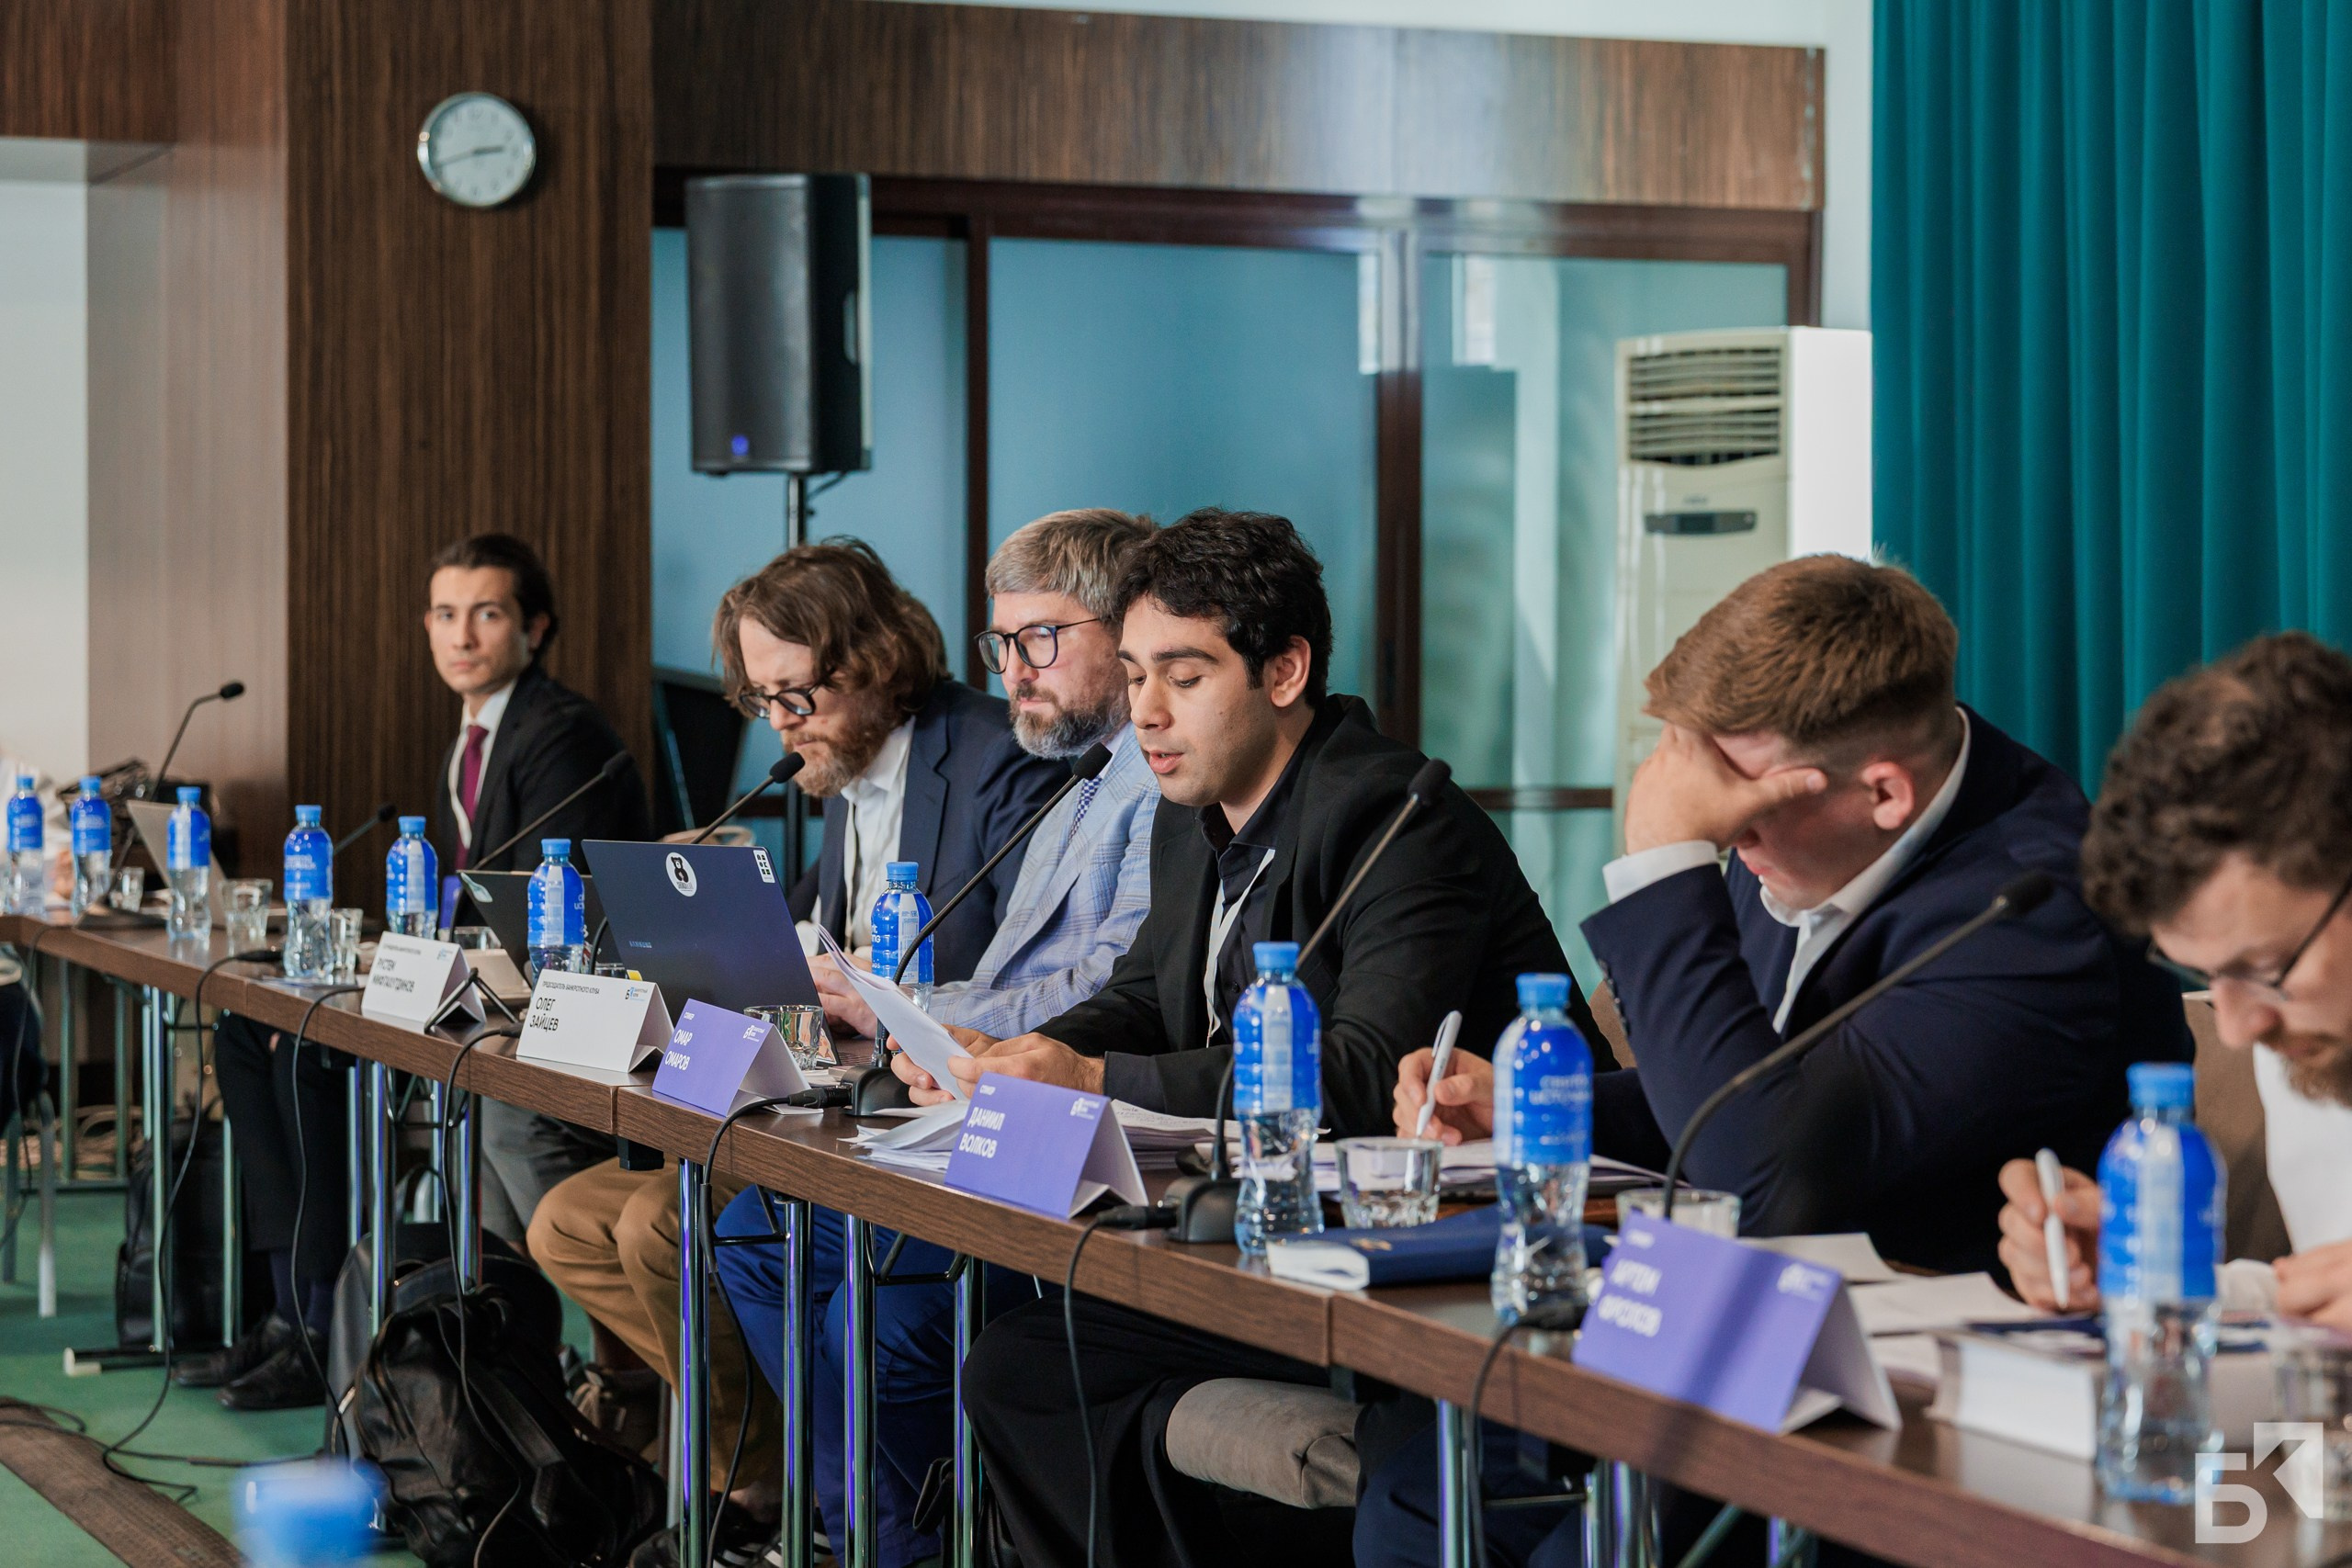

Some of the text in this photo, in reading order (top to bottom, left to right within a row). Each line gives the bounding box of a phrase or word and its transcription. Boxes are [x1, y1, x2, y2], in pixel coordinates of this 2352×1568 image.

[536, 997, 556, 1011] ОЛЕГ
[529, 1013, 560, 1032] ЗАЙЦЕВ
[674, 1030, 693, 1045] ОМАР
[665, 1051, 690, 1070] ОМАРОВ
[967, 1107, 1005, 1131] ДАНИИЛ
[959, 1134, 997, 1158] ВОЛКОВ
